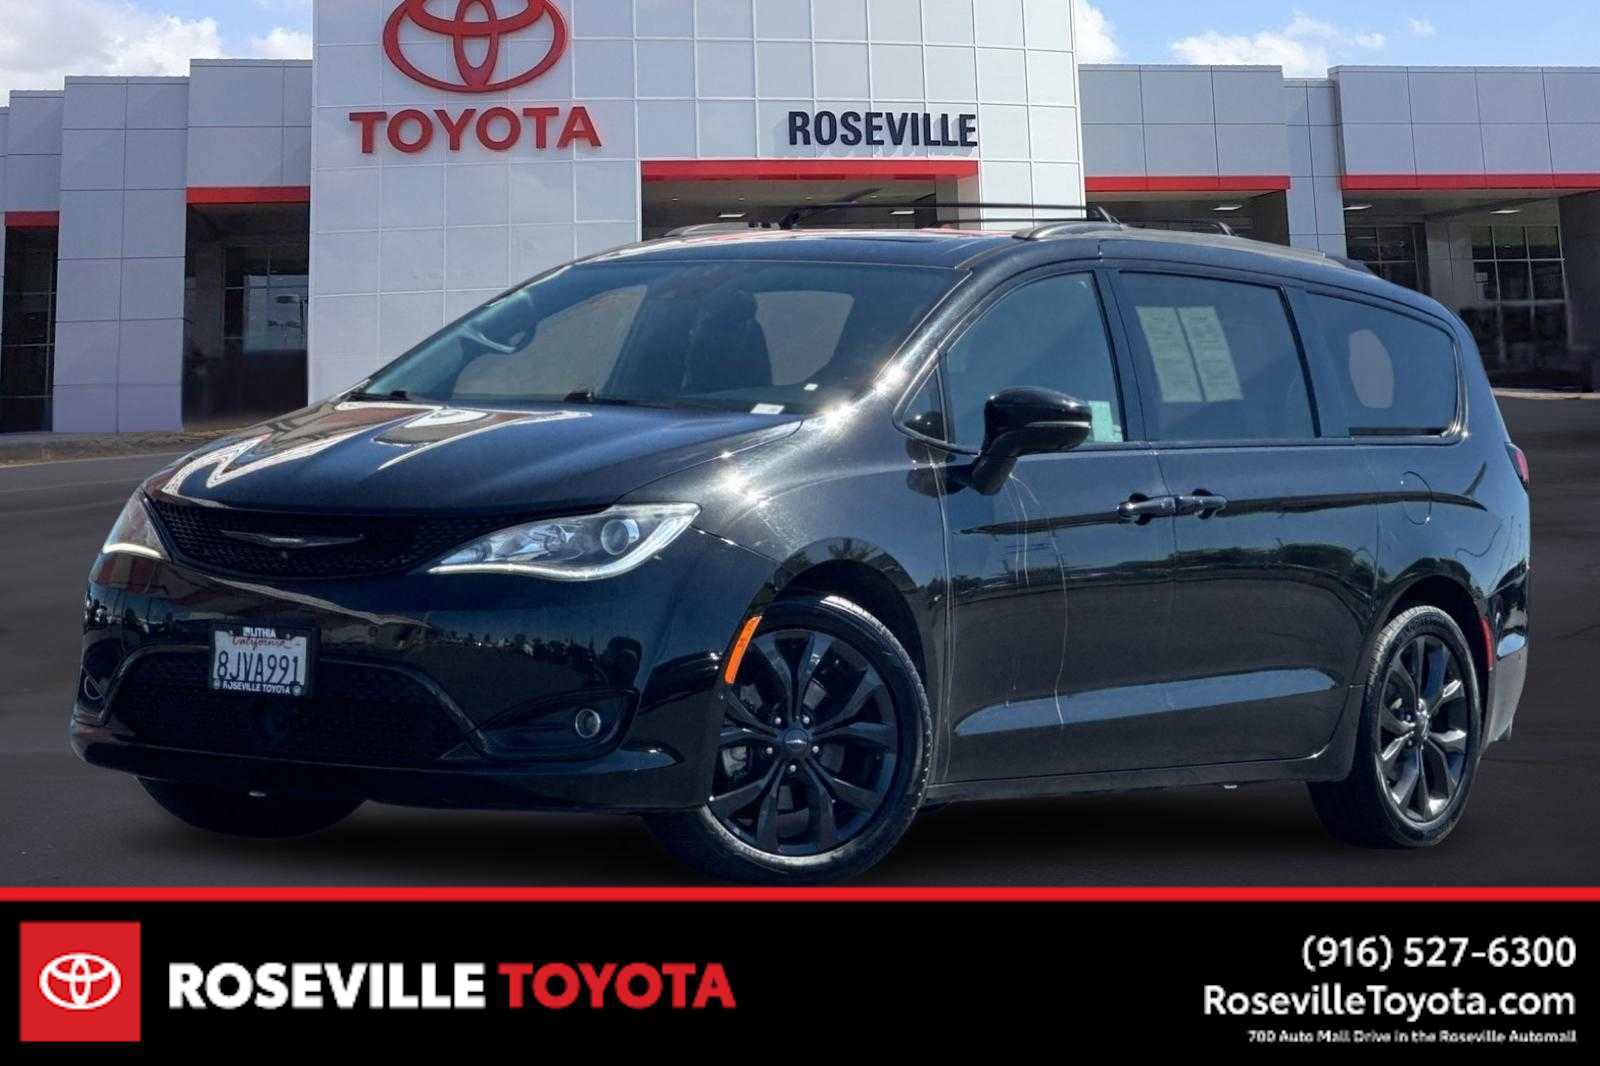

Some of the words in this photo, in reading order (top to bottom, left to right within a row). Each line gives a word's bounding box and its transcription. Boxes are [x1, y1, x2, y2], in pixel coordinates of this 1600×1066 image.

[349, 106, 602, 154] TOYOTA
[788, 111, 978, 147] ROSEVILLE
[217, 650, 299, 685] 8JVA991
[262, 683, 291, 695] TOYOTA
